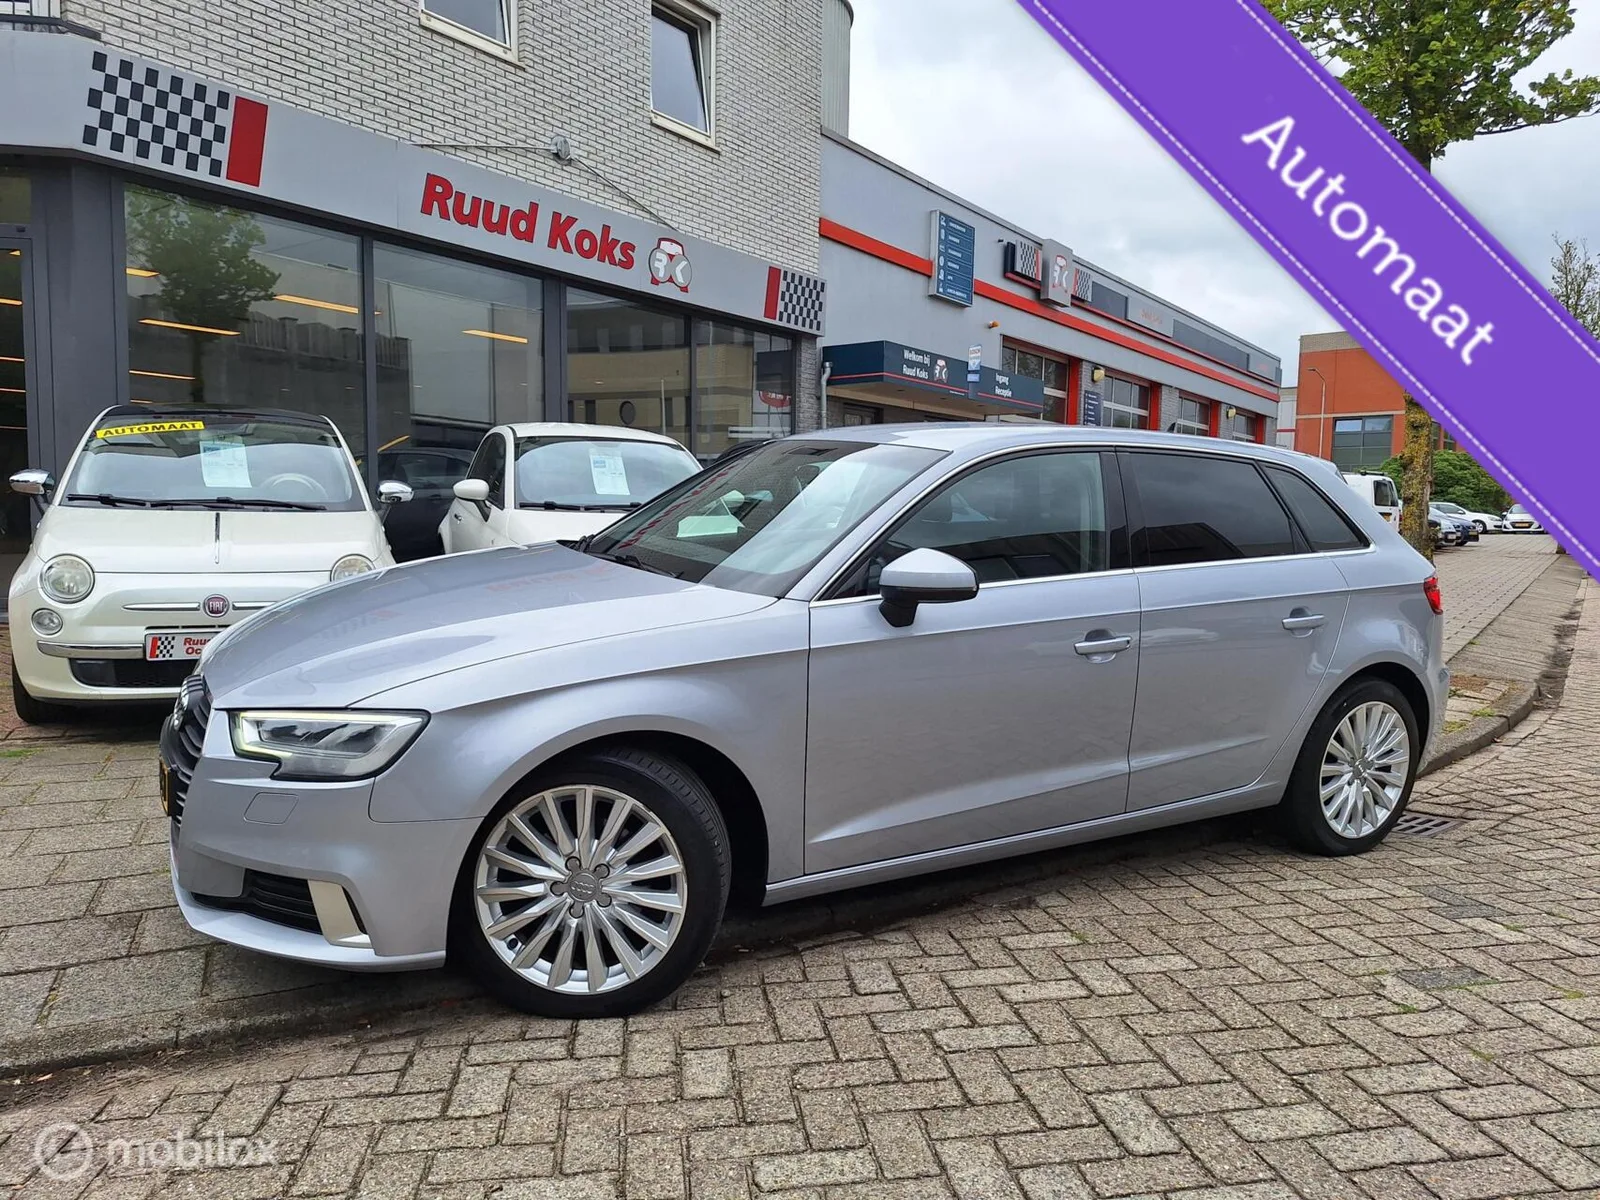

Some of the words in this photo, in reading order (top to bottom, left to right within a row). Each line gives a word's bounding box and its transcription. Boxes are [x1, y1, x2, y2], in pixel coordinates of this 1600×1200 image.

[420, 172, 539, 243] Ruud
[547, 211, 636, 270] Koks
[903, 349, 924, 363] Welkom
[923, 353, 931, 367] bij
[902, 364, 916, 378] Ruud
[916, 367, 929, 380] Koks
[103, 422, 197, 437] AUTOMAAT
[209, 601, 224, 612] FIAT
